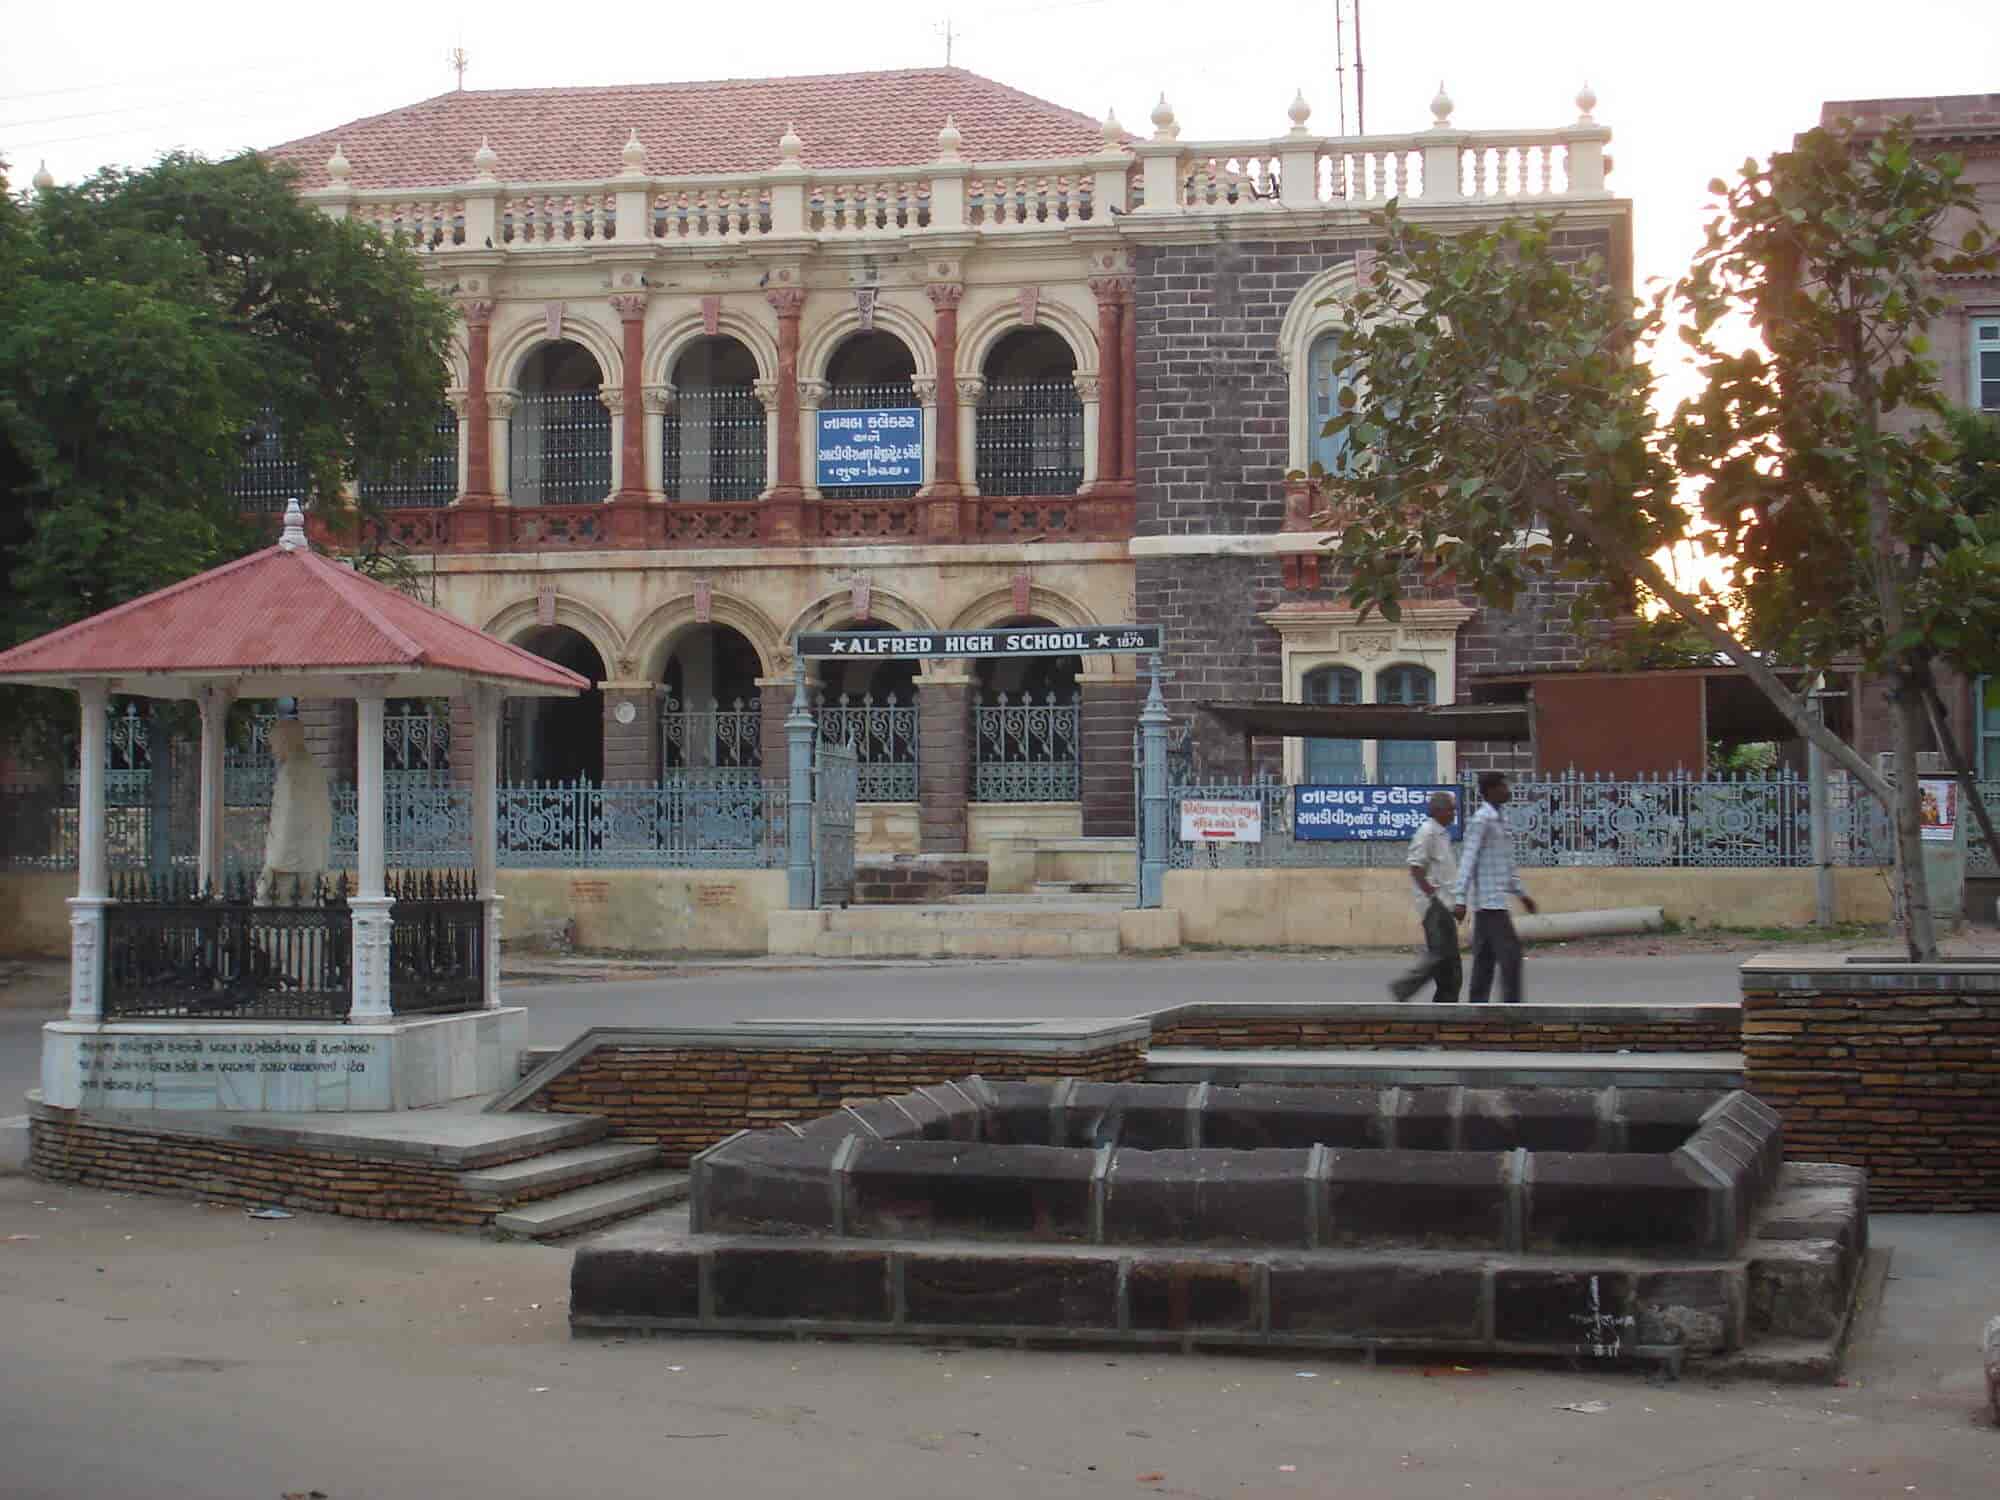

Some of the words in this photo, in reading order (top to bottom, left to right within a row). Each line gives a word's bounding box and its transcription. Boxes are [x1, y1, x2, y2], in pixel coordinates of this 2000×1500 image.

[823, 416, 862, 430] નાયબ
[853, 430, 880, 442] અને
[848, 637, 932, 653] ALFRED
[945, 636, 993, 651] HIGH
[1007, 634, 1089, 650] SCHOOL
[1117, 636, 1144, 647] 1870
[1302, 790, 1363, 804] નાયબ
